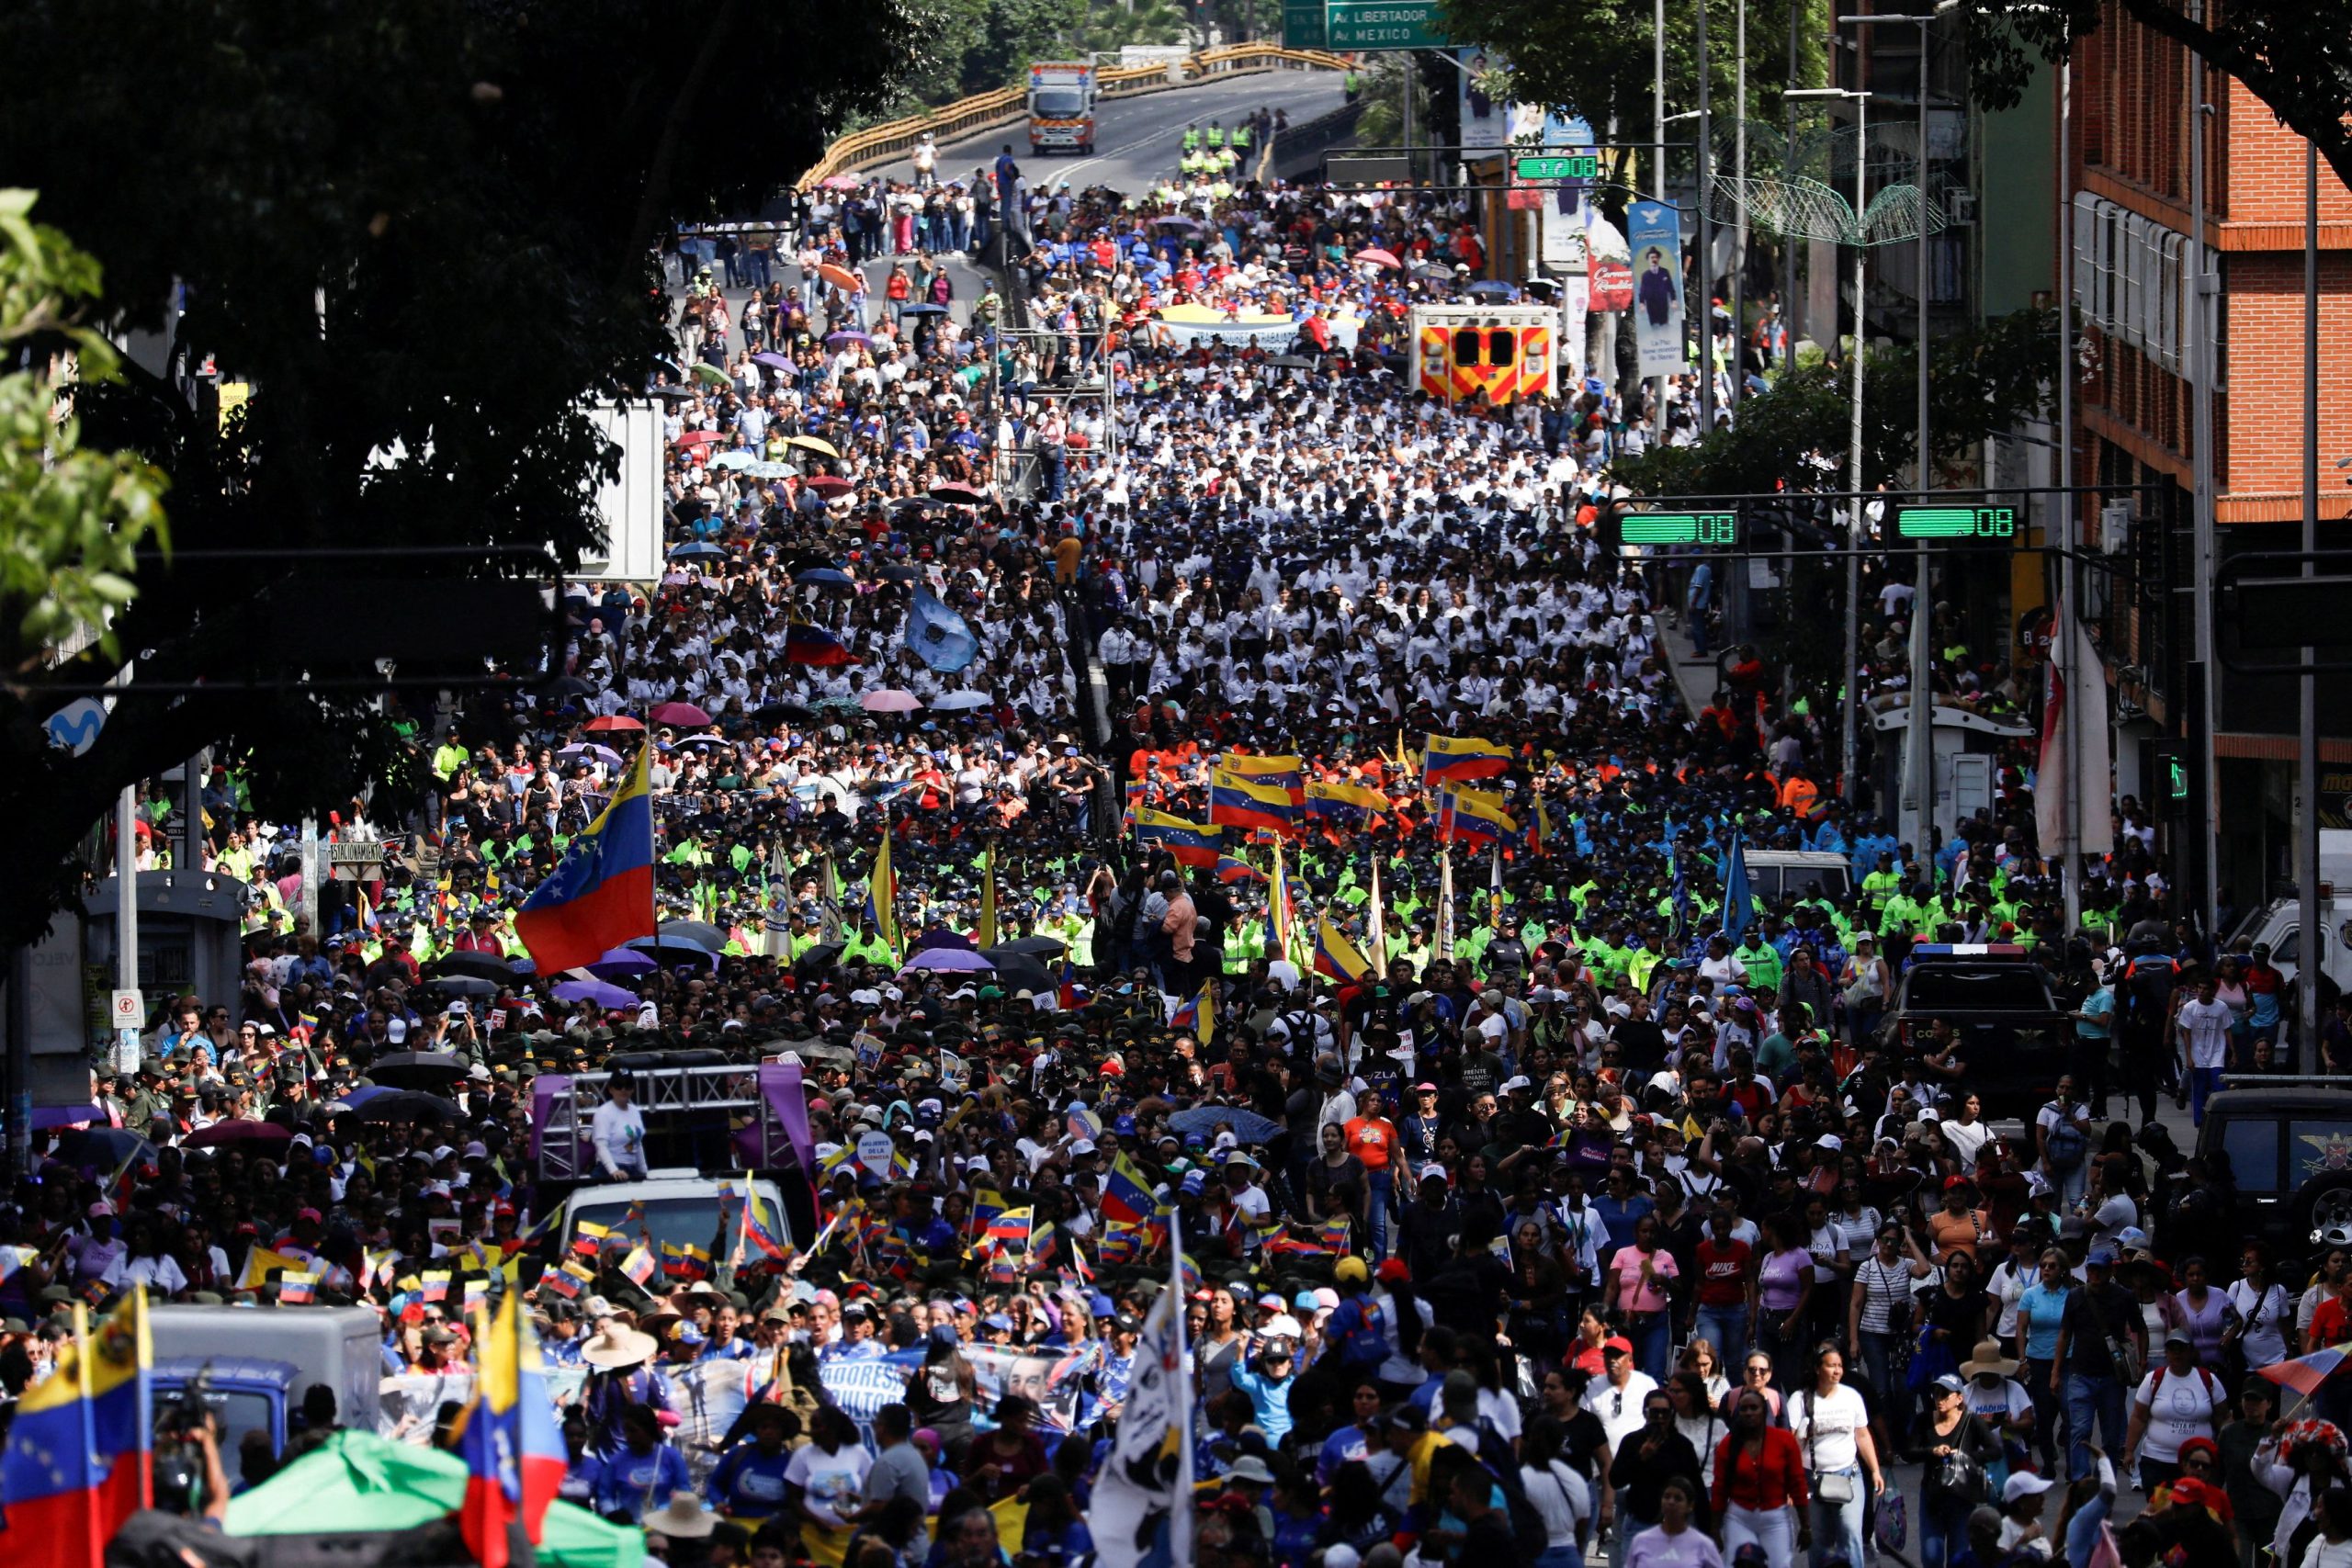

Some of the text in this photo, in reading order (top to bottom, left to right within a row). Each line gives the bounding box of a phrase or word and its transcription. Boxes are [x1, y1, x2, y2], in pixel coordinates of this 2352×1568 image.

[1354, 9, 1427, 23] LIBERTADOR
[1356, 28, 1410, 40] MEXICO
[1570, 157, 1596, 177] 08
[1698, 515, 1734, 543] 08
[1976, 510, 2012, 536] 08
[331, 844, 383, 861] ESTACIONAMIENTO
[1917, 1029, 1960, 1039] COS
[1708, 1261, 1736, 1272] NIKE
